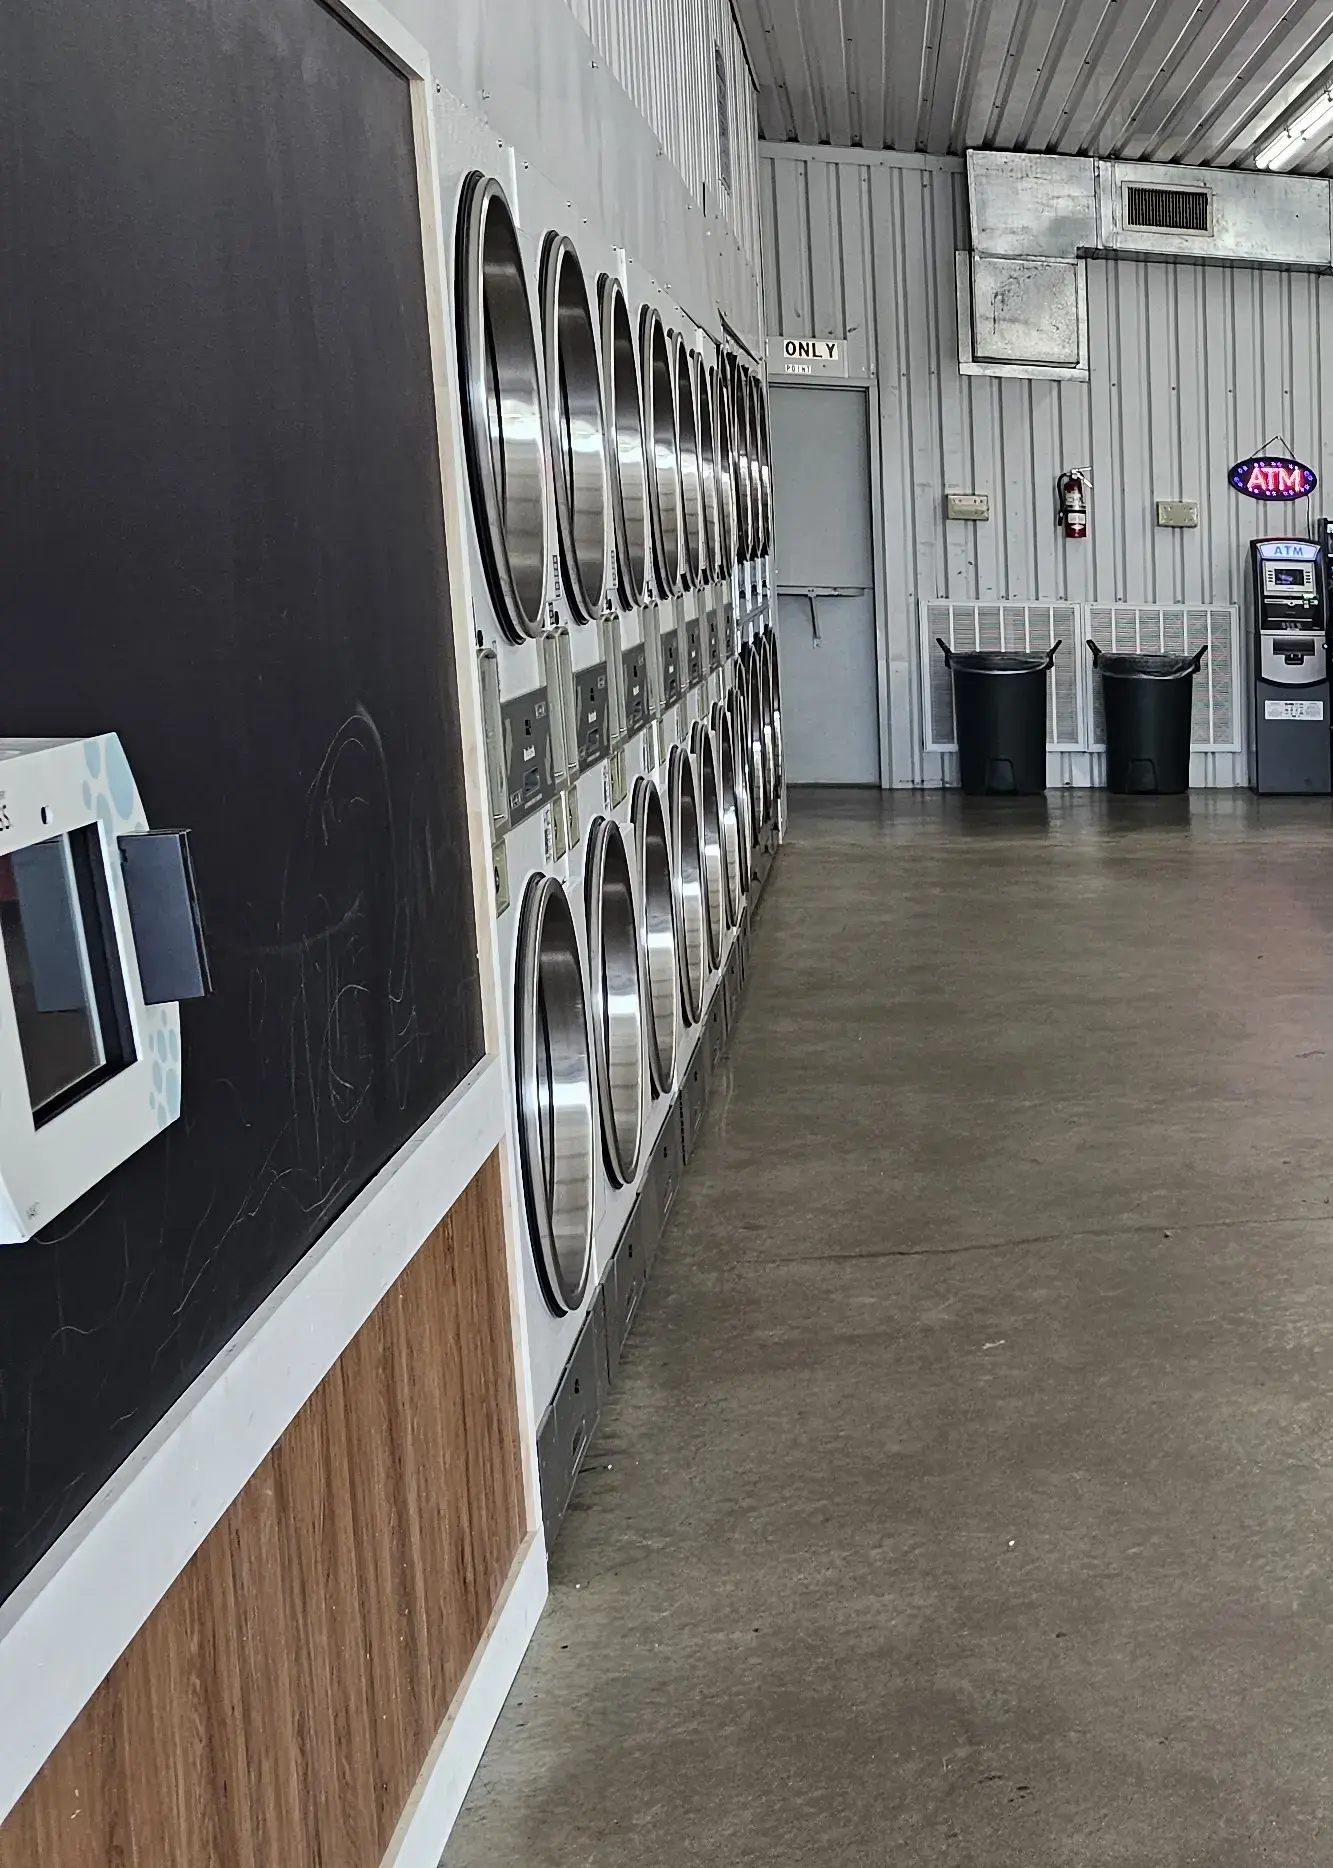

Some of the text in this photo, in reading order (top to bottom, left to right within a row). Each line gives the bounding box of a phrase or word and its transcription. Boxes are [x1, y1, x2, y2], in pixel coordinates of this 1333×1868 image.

[785, 341, 836, 358] ONLY
[1247, 466, 1301, 492] ATM
[1274, 546, 1303, 555] ATM
